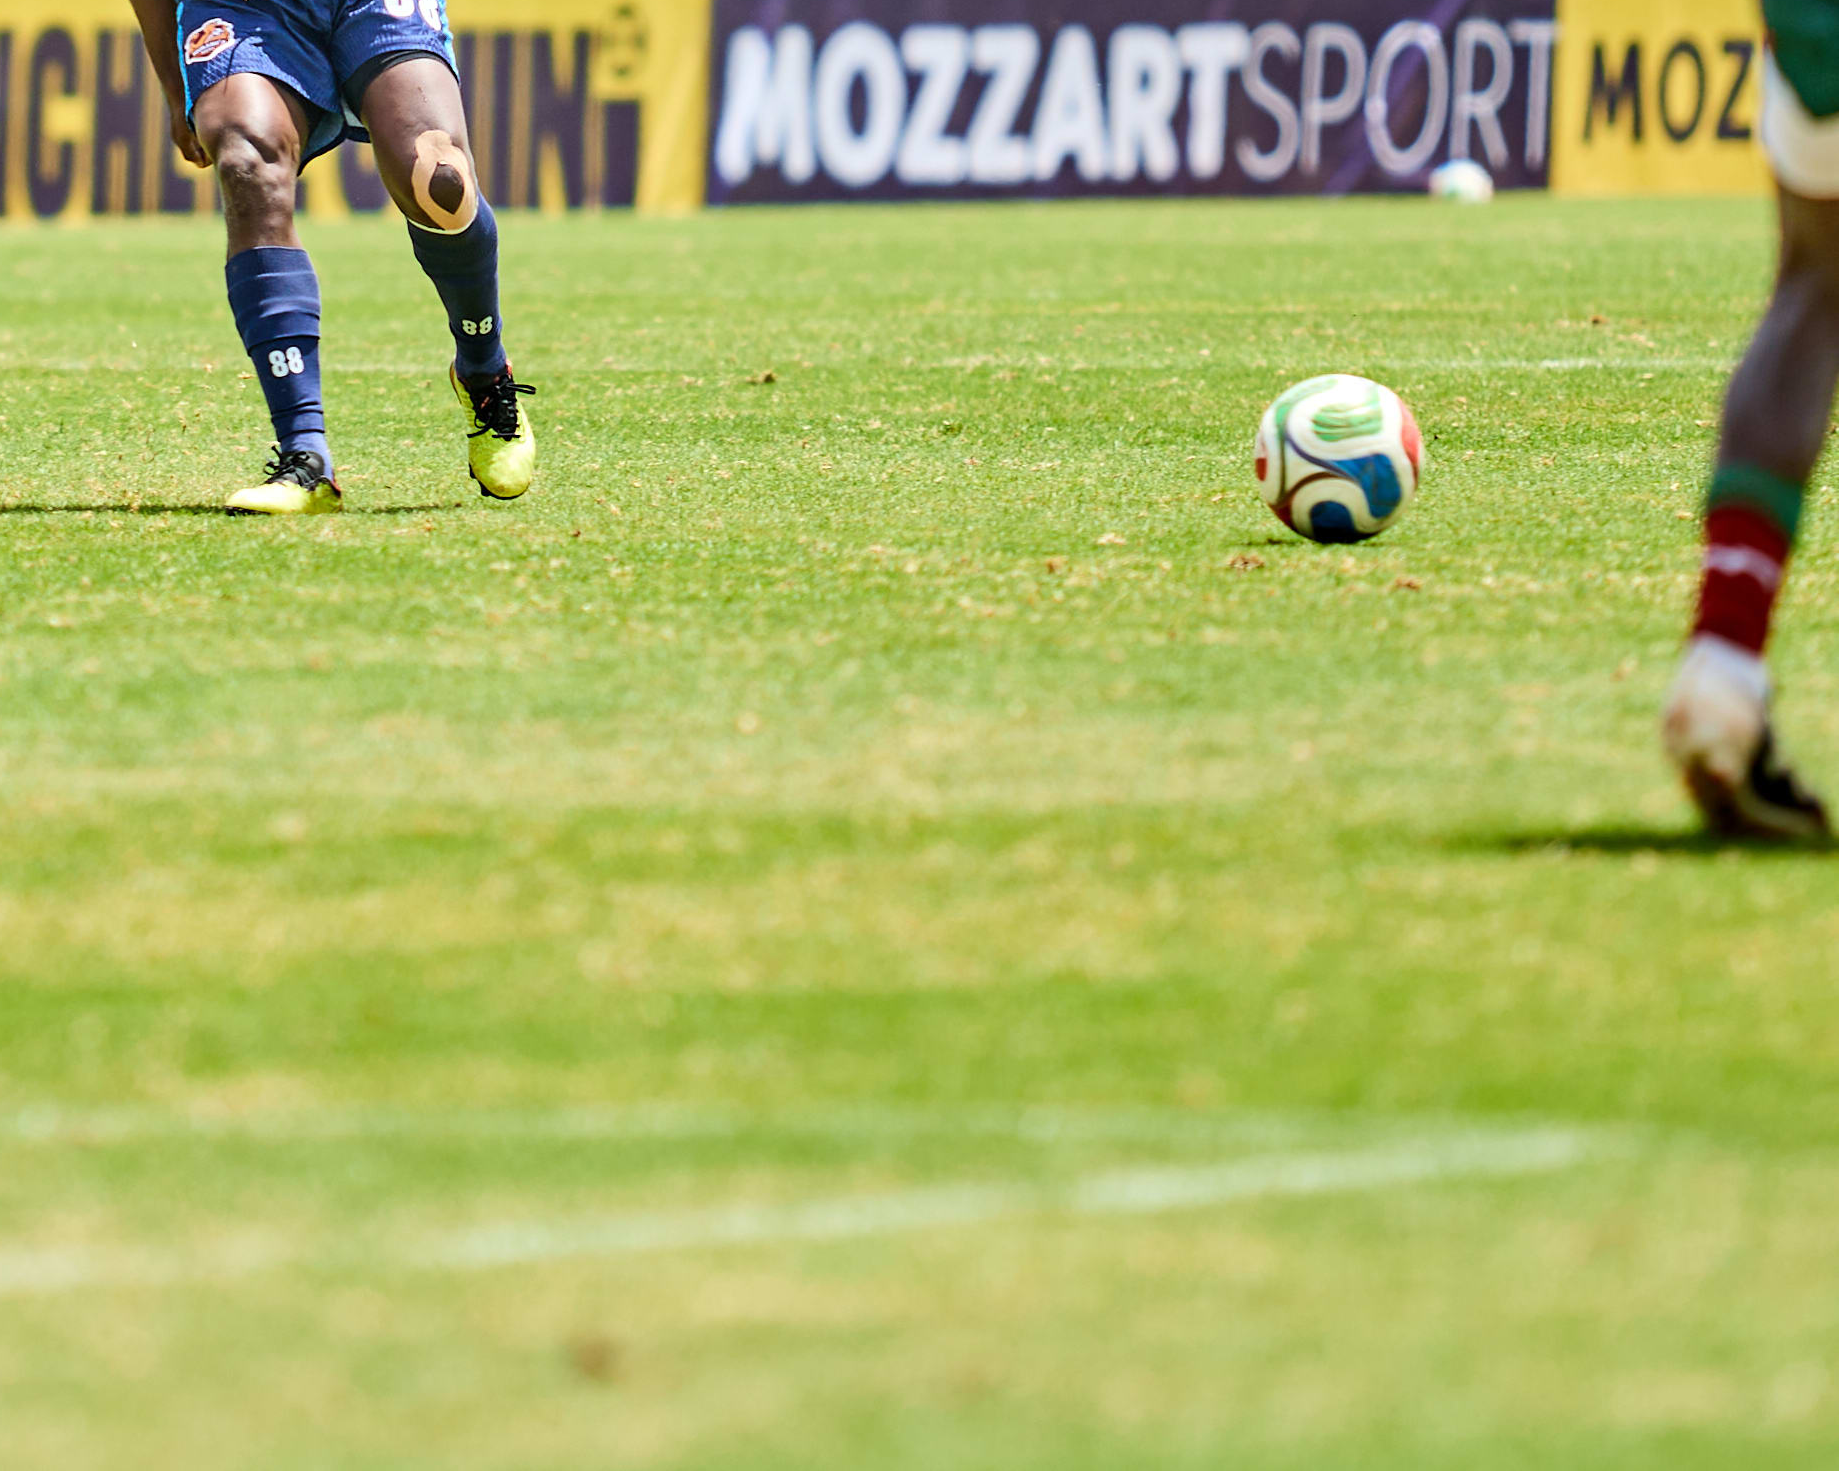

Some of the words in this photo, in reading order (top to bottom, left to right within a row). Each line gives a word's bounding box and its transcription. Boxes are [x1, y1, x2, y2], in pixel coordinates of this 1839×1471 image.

[715, 19, 1556, 187] MOZZARTSPORT
[1582, 37, 1754, 144] MOZ
[462, 316, 493, 336] 88
[268, 346, 305, 378] 88
